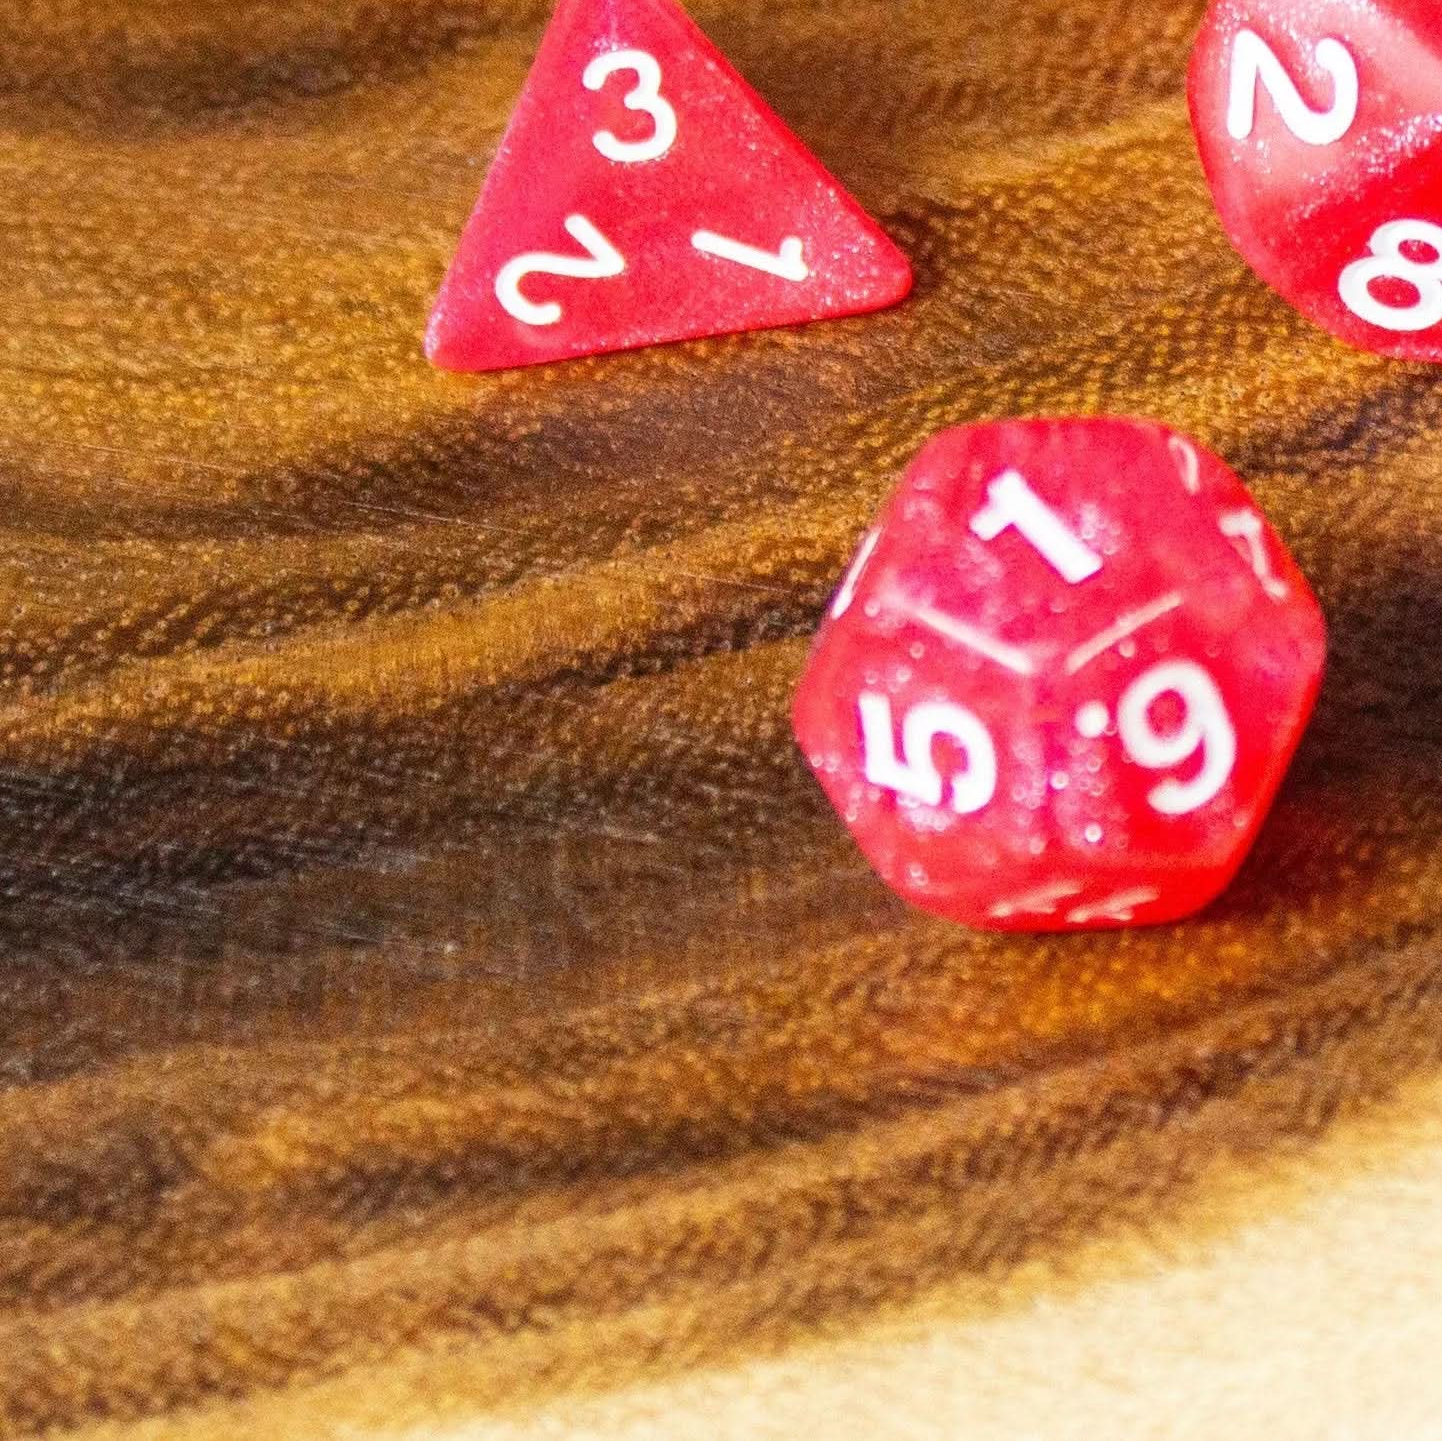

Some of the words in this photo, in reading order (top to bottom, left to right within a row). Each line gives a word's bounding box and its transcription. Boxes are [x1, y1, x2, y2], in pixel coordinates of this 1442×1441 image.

[583, 50, 677, 162] 3
[1227, 30, 1358, 145] 2
[495, 214, 625, 326] 2
[691, 230, 810, 282] 1
[972, 471, 1102, 583] 1
[859, 693, 996, 814] 5
